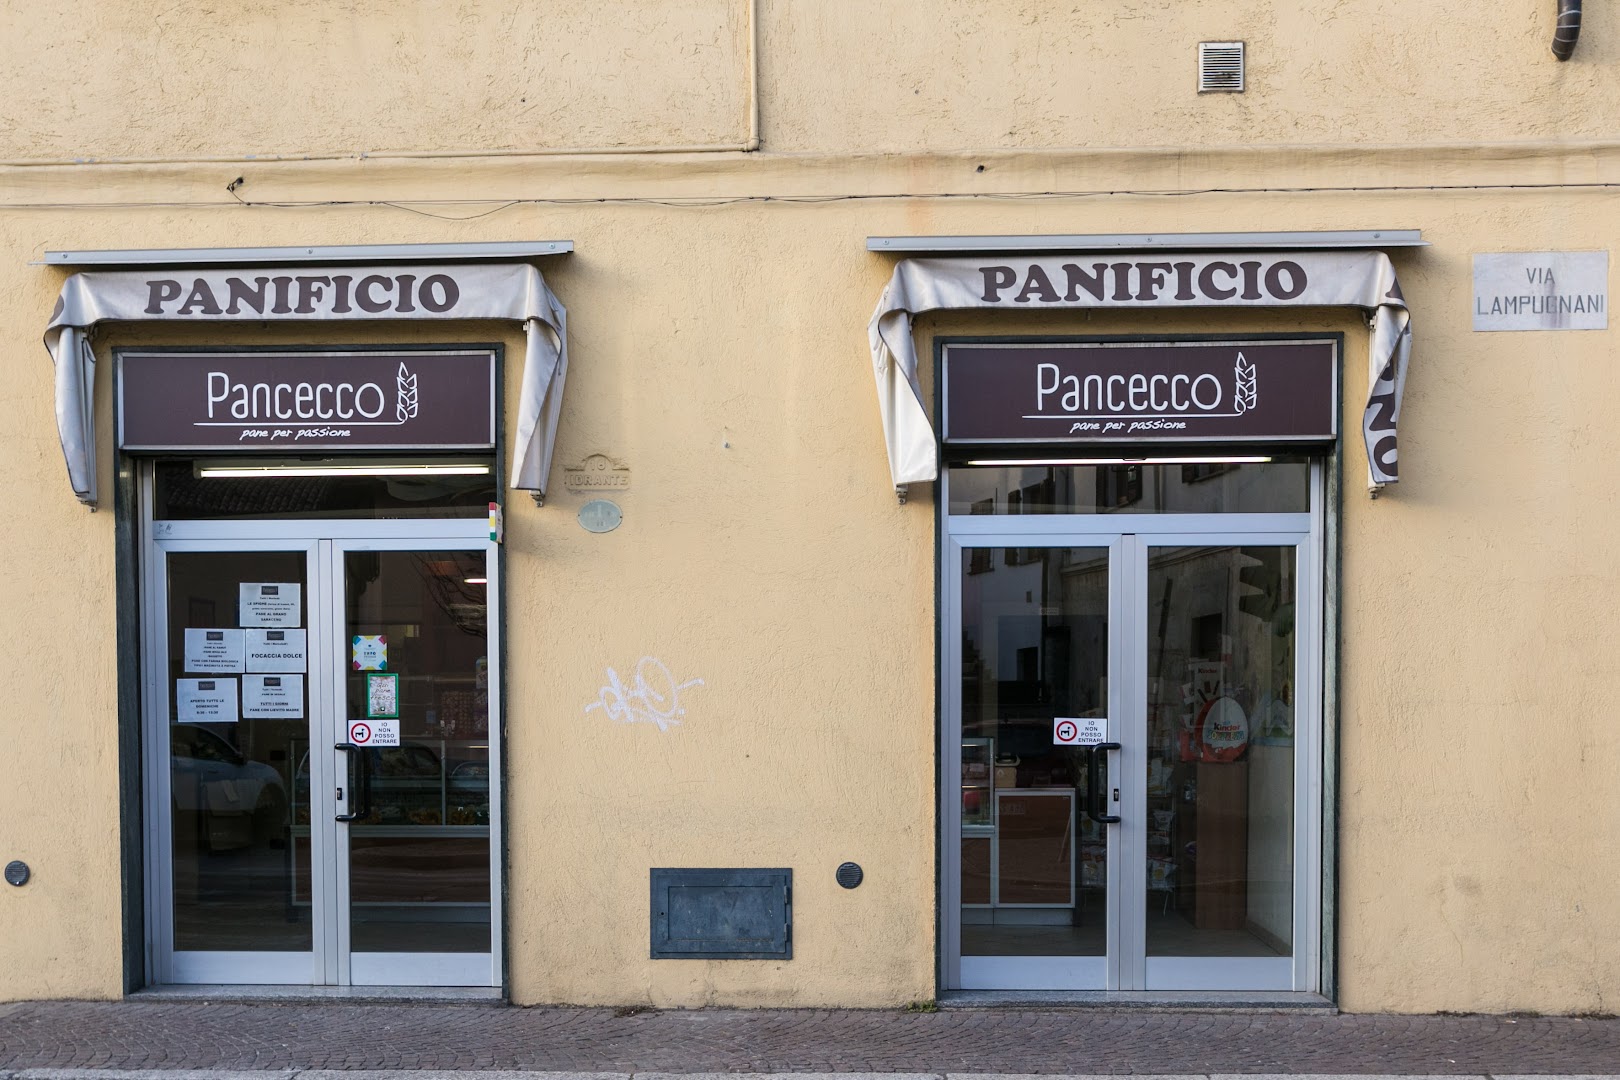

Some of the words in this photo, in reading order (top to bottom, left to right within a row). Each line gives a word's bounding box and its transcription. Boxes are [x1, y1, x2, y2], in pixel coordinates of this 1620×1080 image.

[978, 260, 1308, 303] PANIFICIO
[1526, 267, 1555, 284] VIA
[143, 273, 460, 316] PANIFICIO
[1477, 294, 1604, 315] LAMPUGNANI
[207, 371, 385, 420] Pancecco
[1036, 362, 1222, 412] Pancecco
[239, 428, 269, 441] pane
[272, 428, 293, 441] per
[295, 425, 351, 441] passione
[1069, 421, 1101, 434] pane
[1104, 421, 1126, 434] per
[1128, 417, 1187, 434] passione
[570, 474, 628, 486] IDRANTE
